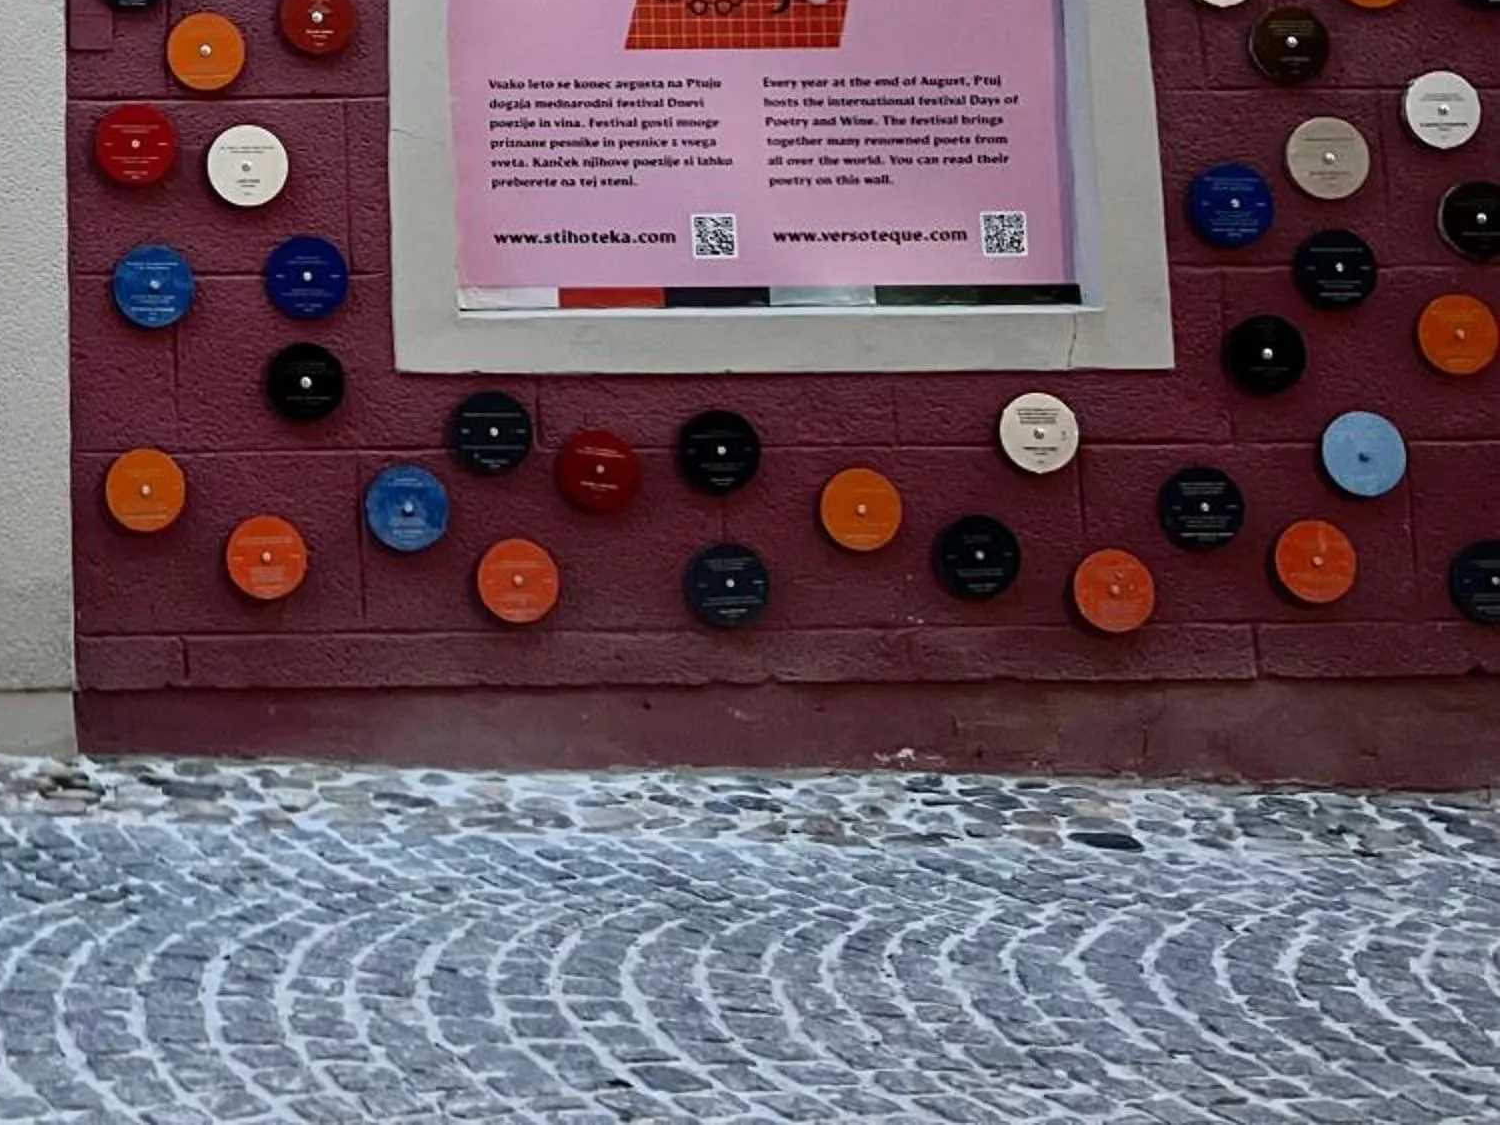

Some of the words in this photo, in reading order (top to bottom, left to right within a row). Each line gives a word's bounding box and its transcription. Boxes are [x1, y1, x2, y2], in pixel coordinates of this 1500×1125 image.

[489, 79, 525, 90] Vsako
[528, 79, 554, 89] leto
[558, 81, 571, 89] se
[573, 79, 611, 89] konec
[615, 80, 664, 91] avgusta
[667, 80, 682, 88] na
[686, 78, 722, 90] Ptuju
[763, 77, 797, 90] Every
[801, 78, 828, 90] year
[832, 78, 845, 87] at
[850, 77, 871, 87] the
[874, 76, 899, 86] end
[902, 76, 917, 86] of
[920, 76, 970, 88] August,
[974, 75, 1002, 88] Ptuj
[489, 99, 531, 111] dogaja
[535, 98, 613, 108] mednarodni
[616, 98, 664, 108] festival
[667, 97, 704, 107] Dnevi
[764, 97, 799, 107] hosts
[803, 97, 824, 107] the
[828, 96, 915, 106] international
[918, 95, 966, 106] festival
[969, 95, 1000, 107] Days
[1004, 95, 1019, 105] of
[489, 119, 536, 131] poezije
[539, 119, 551, 128] in
[554, 118, 585, 128] vina.
[589, 118, 638, 128] Festival
[641, 117, 673, 129] gosti
[676, 118, 719, 129] mnoge
[765, 117, 808, 128] Poetry
[812, 116, 836, 126] and
[839, 116, 877, 126] Wine.
[883, 115, 907, 125] The
[911, 115, 958, 125] festival
[961, 115, 1004, 127] brings
[490, 138, 547, 149] priznane
[549, 138, 600, 149] pesnike
[603, 137, 615, 147] in
[619, 138, 668, 149] pesnice
[681, 139, 717, 149] vsega
[767, 135, 822, 148] together
[827, 137, 860, 147] many
[864, 135, 930, 145] renowned
[933, 135, 971, 146] poets
[974, 134, 1008, 144] from
[491, 158, 529, 167] sveta.
[582, 157, 628, 168] njihove
[632, 156, 680, 168] poezije
[684, 156, 694, 166] si
[697, 156, 733, 166] lahko
[768, 156, 783, 166] all
[786, 156, 813, 165] over
[818, 155, 839, 165] the
[843, 155, 884, 165] world.
[889, 154, 913, 164] You
[916, 155, 939, 164] can
[943, 154, 973, 164] read
[977, 153, 1009, 163] their
[491, 176, 558, 188] preberete
[560, 177, 576, 187] na
[580, 176, 597, 188] tej
[600, 175, 637, 187] steni.
[769, 175, 812, 187] poetry
[815, 176, 832, 185] on
[836, 174, 860, 185] this
[863, 174, 894, 184] wall.
[494, 229, 676, 245] www.stihoteka.com
[773, 228, 967, 245] www.versoteque.com
